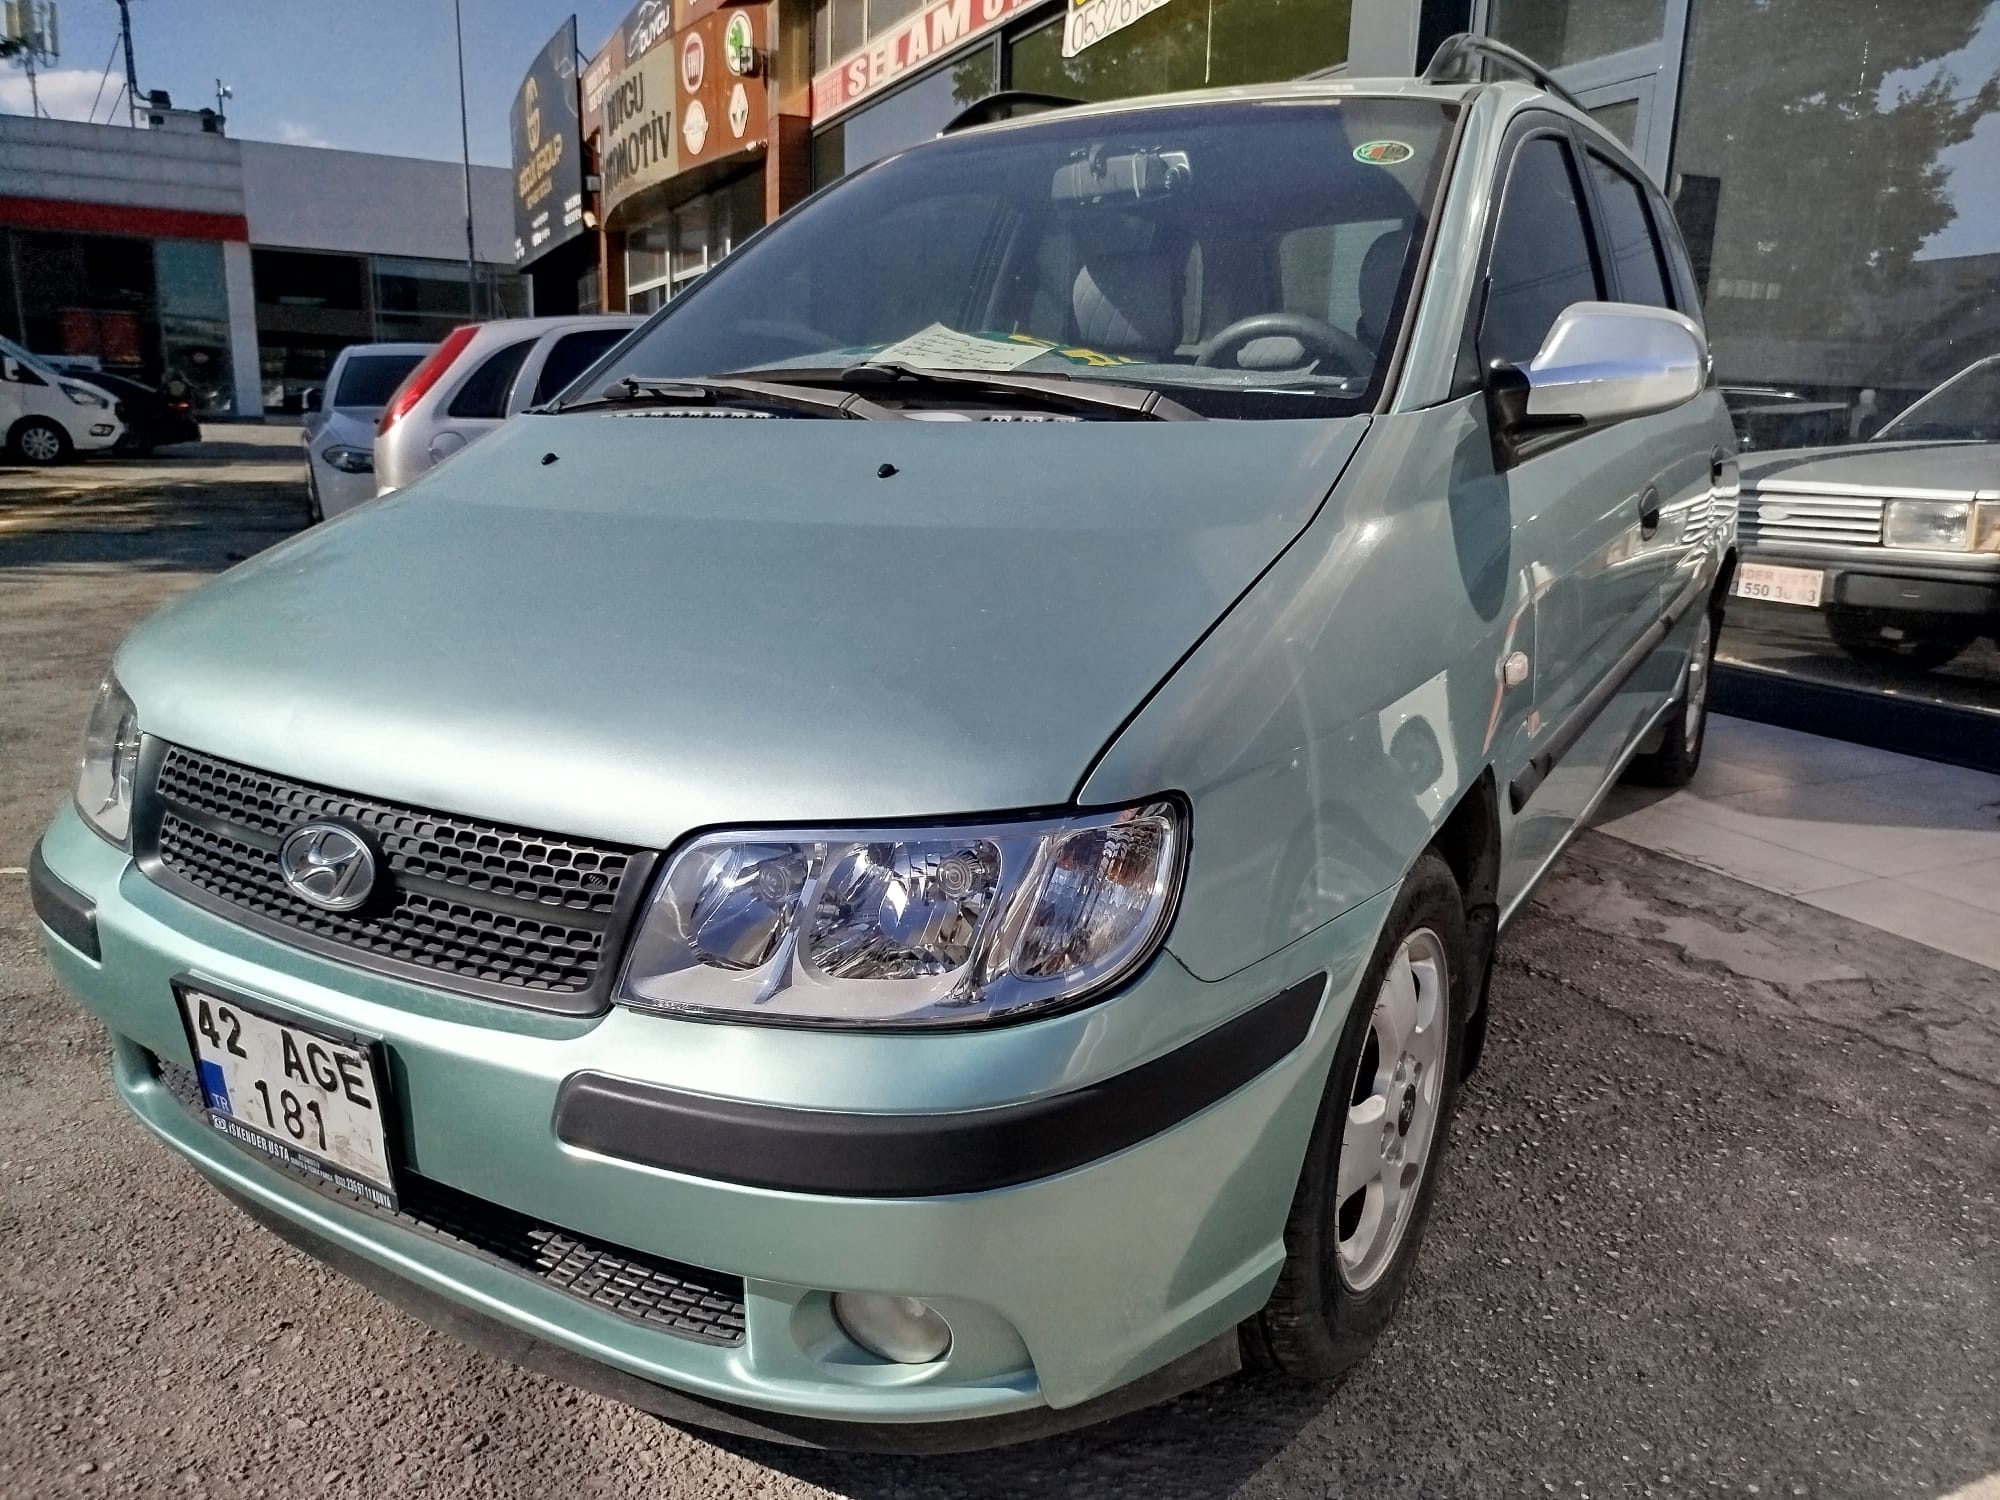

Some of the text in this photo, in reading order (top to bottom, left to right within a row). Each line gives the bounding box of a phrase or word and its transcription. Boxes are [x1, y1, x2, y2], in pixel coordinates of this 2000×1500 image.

[847, 1, 971, 98] SELAM
[1743, 582, 1770, 597] 550
[198, 999, 372, 1110] 42 AGE
[211, 1092, 230, 1112] TR
[254, 1079, 327, 1151] 181
[268, 1140, 290, 1162] USTA
